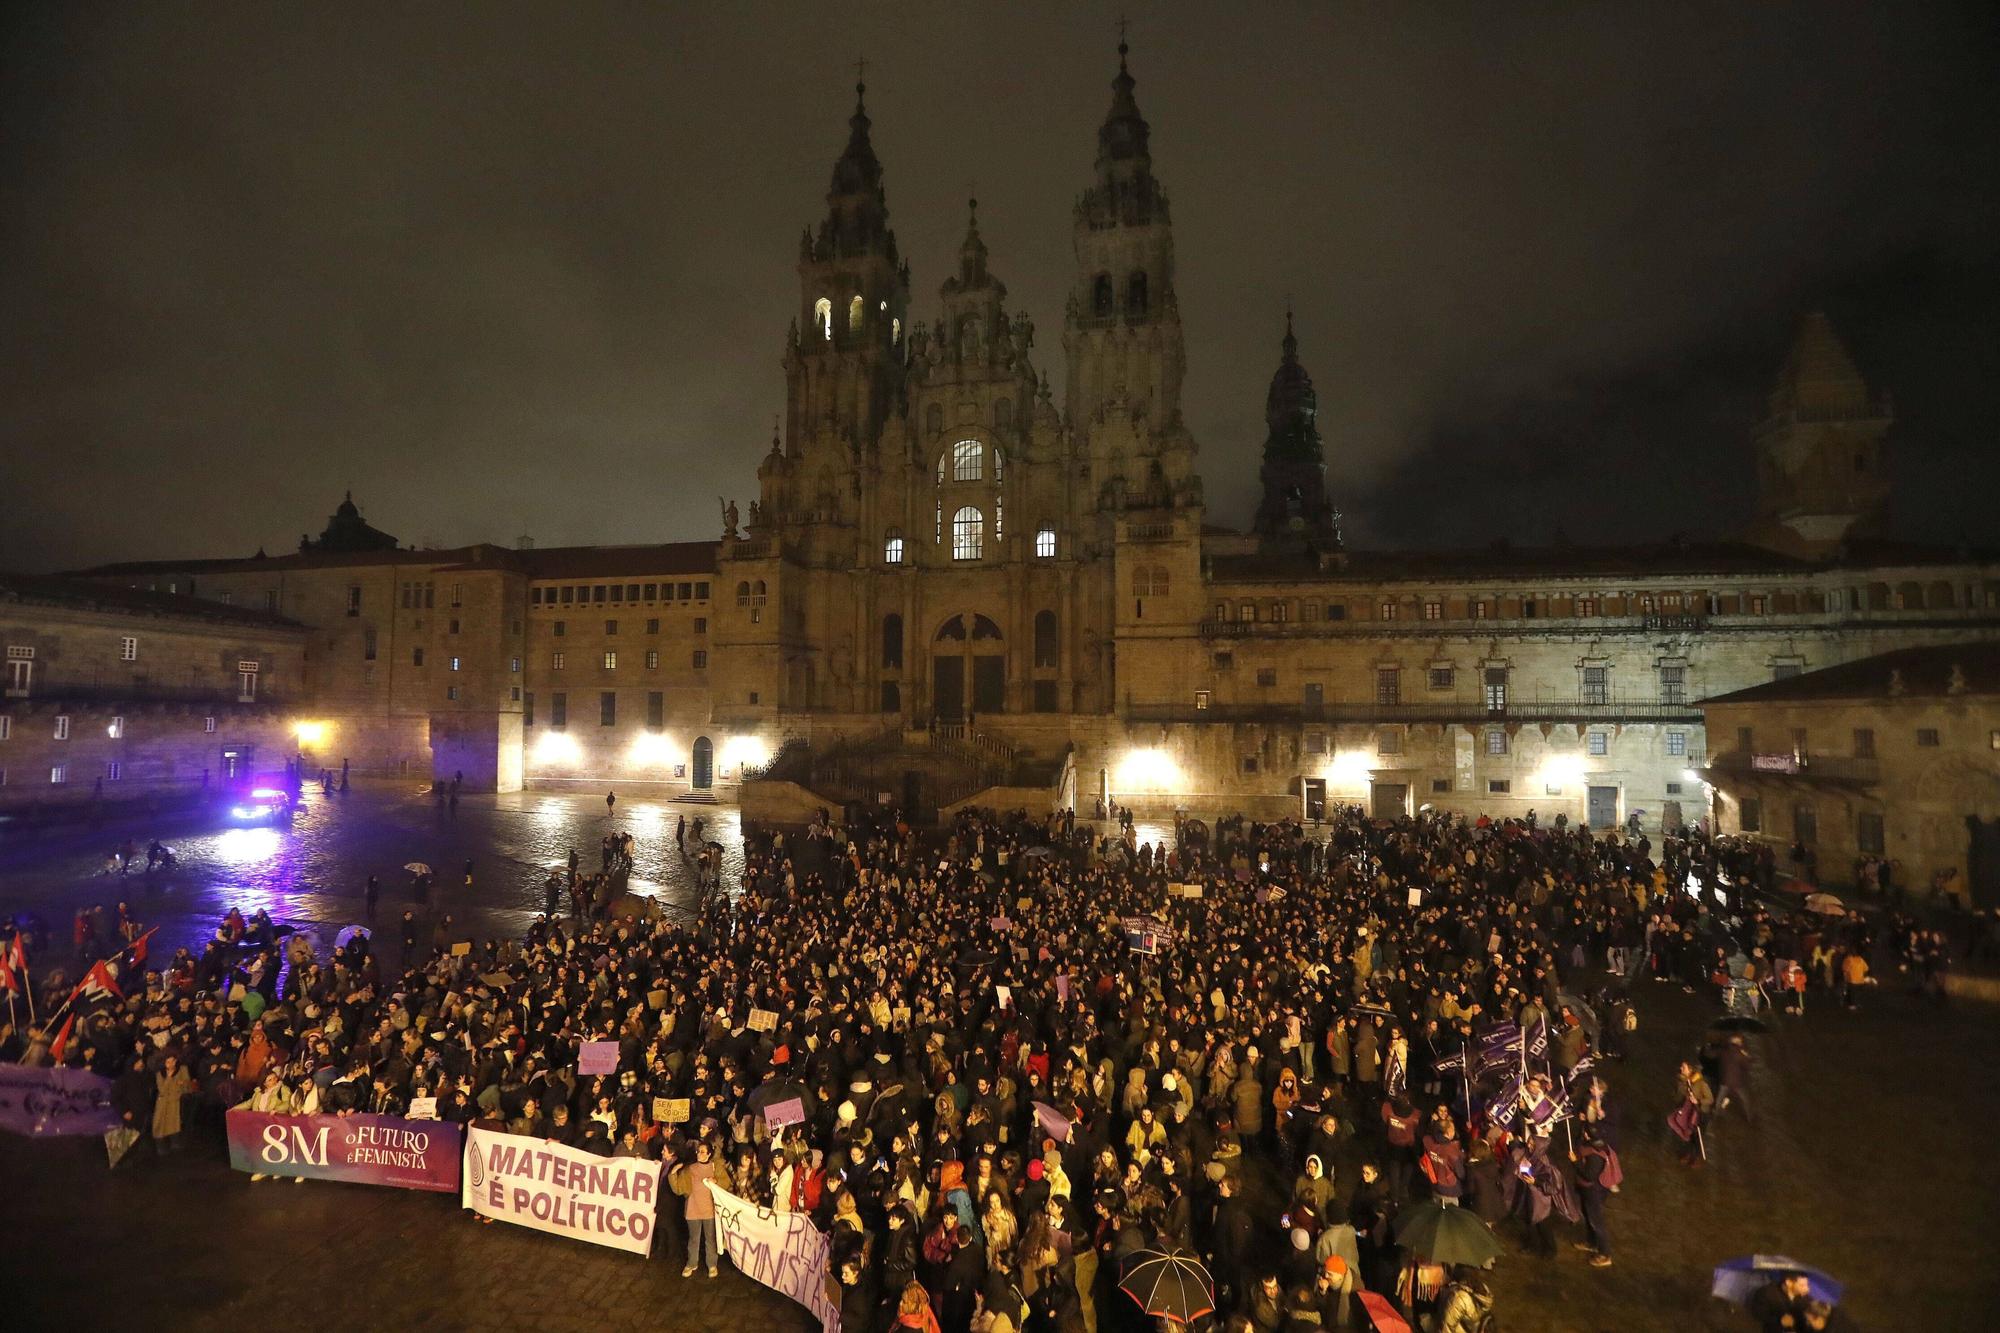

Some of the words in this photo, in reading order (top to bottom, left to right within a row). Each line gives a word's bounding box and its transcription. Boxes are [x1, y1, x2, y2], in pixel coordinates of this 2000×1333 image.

[261, 1124, 331, 1166] 8M
[354, 1148, 427, 1170] FEMINISTA
[357, 1126, 429, 1154] FUTURO
[488, 1144, 654, 1203] MATERNAR
[489, 1175, 505, 1209] É
[513, 1187, 650, 1241] POLÍTICO
